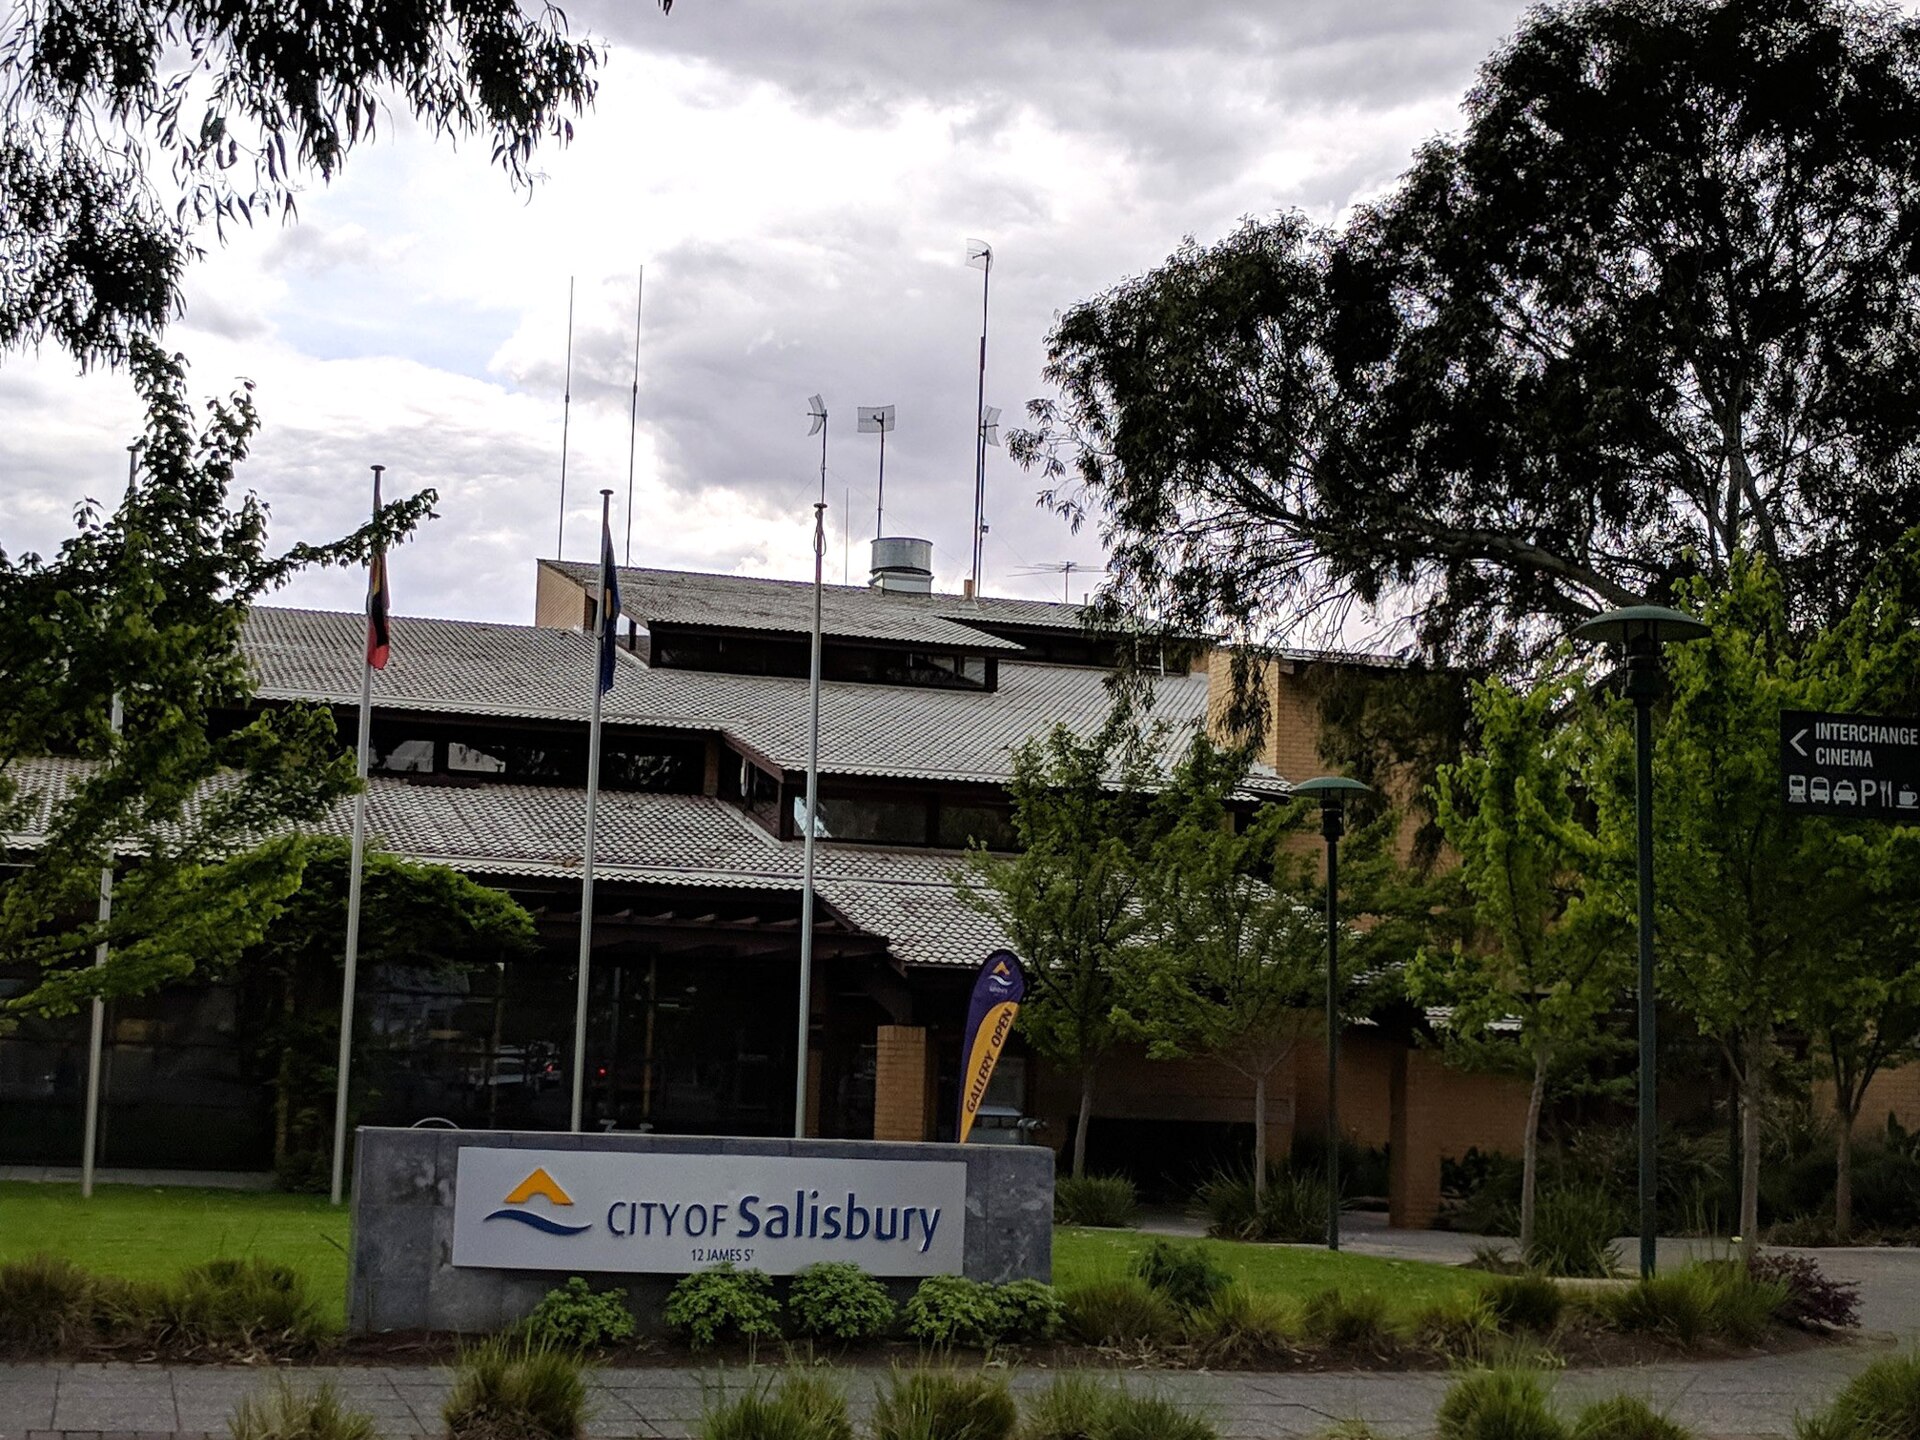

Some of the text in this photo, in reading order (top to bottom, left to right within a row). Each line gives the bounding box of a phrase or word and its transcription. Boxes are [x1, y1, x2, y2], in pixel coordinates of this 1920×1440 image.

[1815, 722, 1919, 745] INTERCHANGE
[1815, 747, 1874, 768] CINEMA
[966, 1050, 995, 1114] GALLERY
[991, 1007, 1013, 1047] OPEN
[737, 1189, 941, 1254] Salisbury
[691, 1249, 704, 1262] 12
[706, 1249, 742, 1262] JAMES
